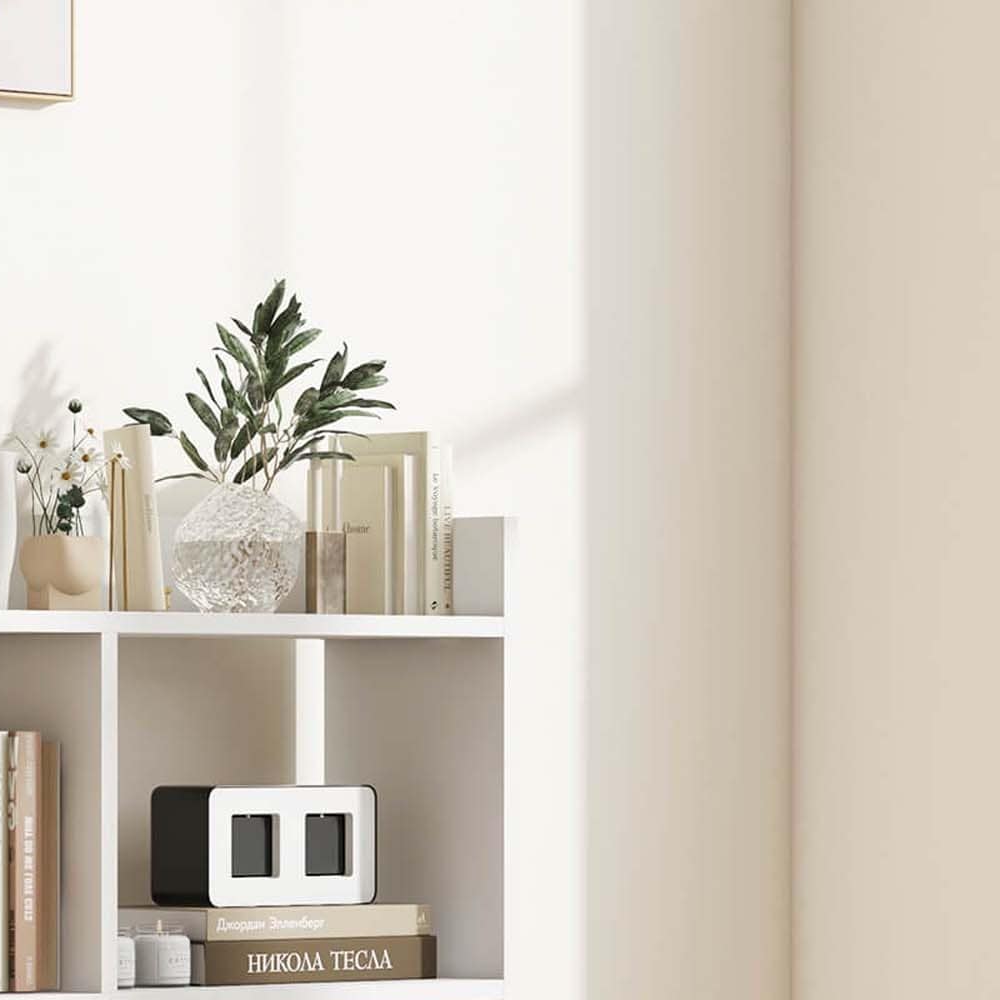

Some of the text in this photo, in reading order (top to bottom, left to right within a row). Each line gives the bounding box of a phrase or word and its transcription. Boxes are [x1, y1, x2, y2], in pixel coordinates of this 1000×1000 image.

[216, 917, 265, 933] Джордан
[247, 949, 393, 974] НИКОЛА ТЕСЛА
